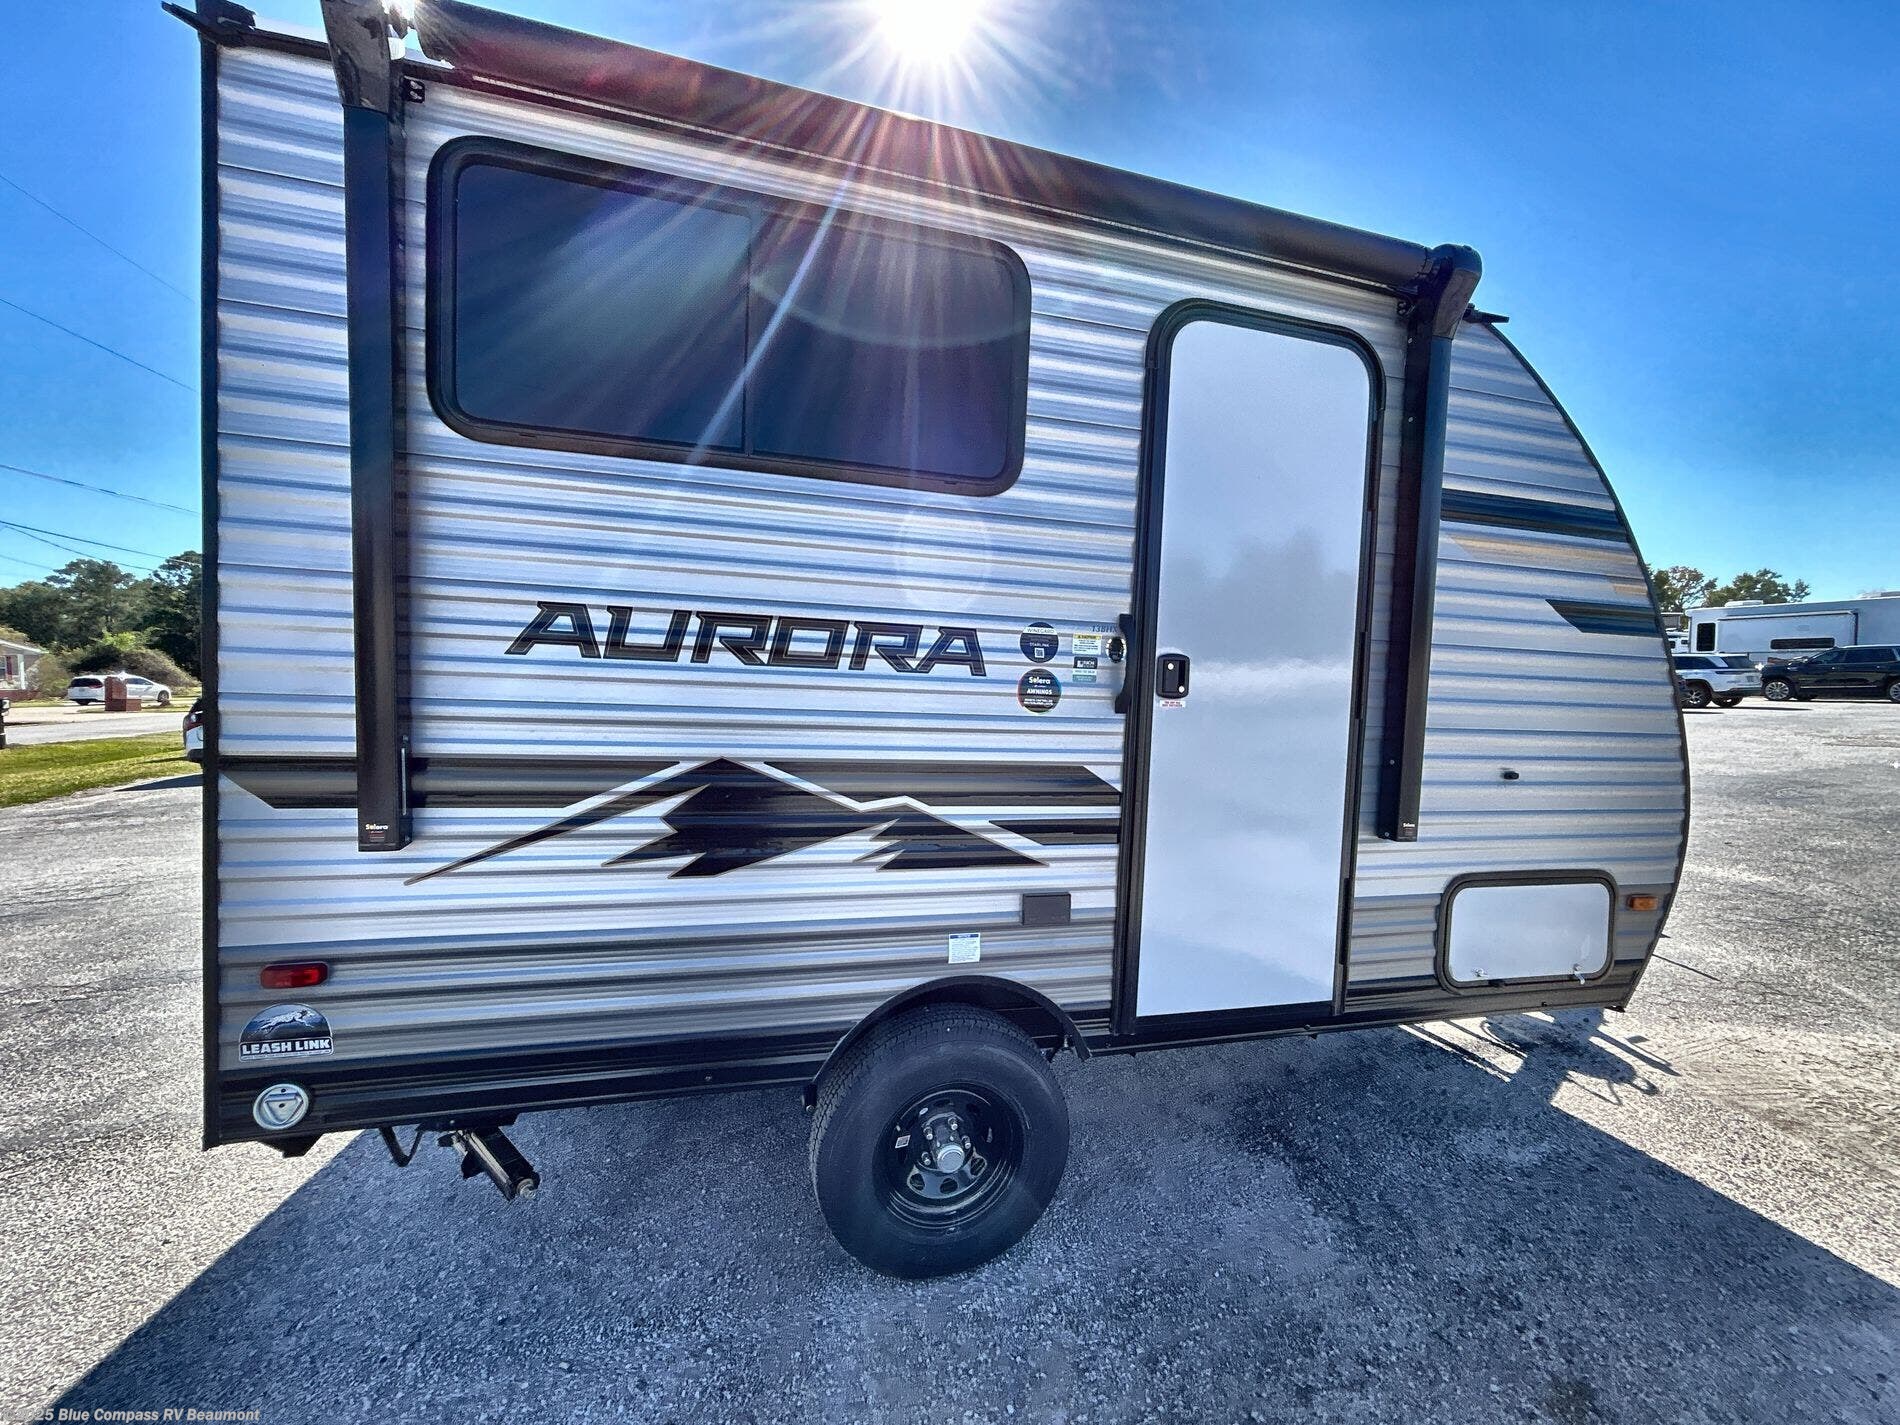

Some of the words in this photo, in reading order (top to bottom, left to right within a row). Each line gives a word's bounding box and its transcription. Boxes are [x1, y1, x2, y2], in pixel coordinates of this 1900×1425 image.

[504, 600, 987, 677] AURORA
[1028, 676, 1051, 685] Solera
[242, 1041, 292, 1055] LEASH
[295, 1039, 330, 1051] LINK
